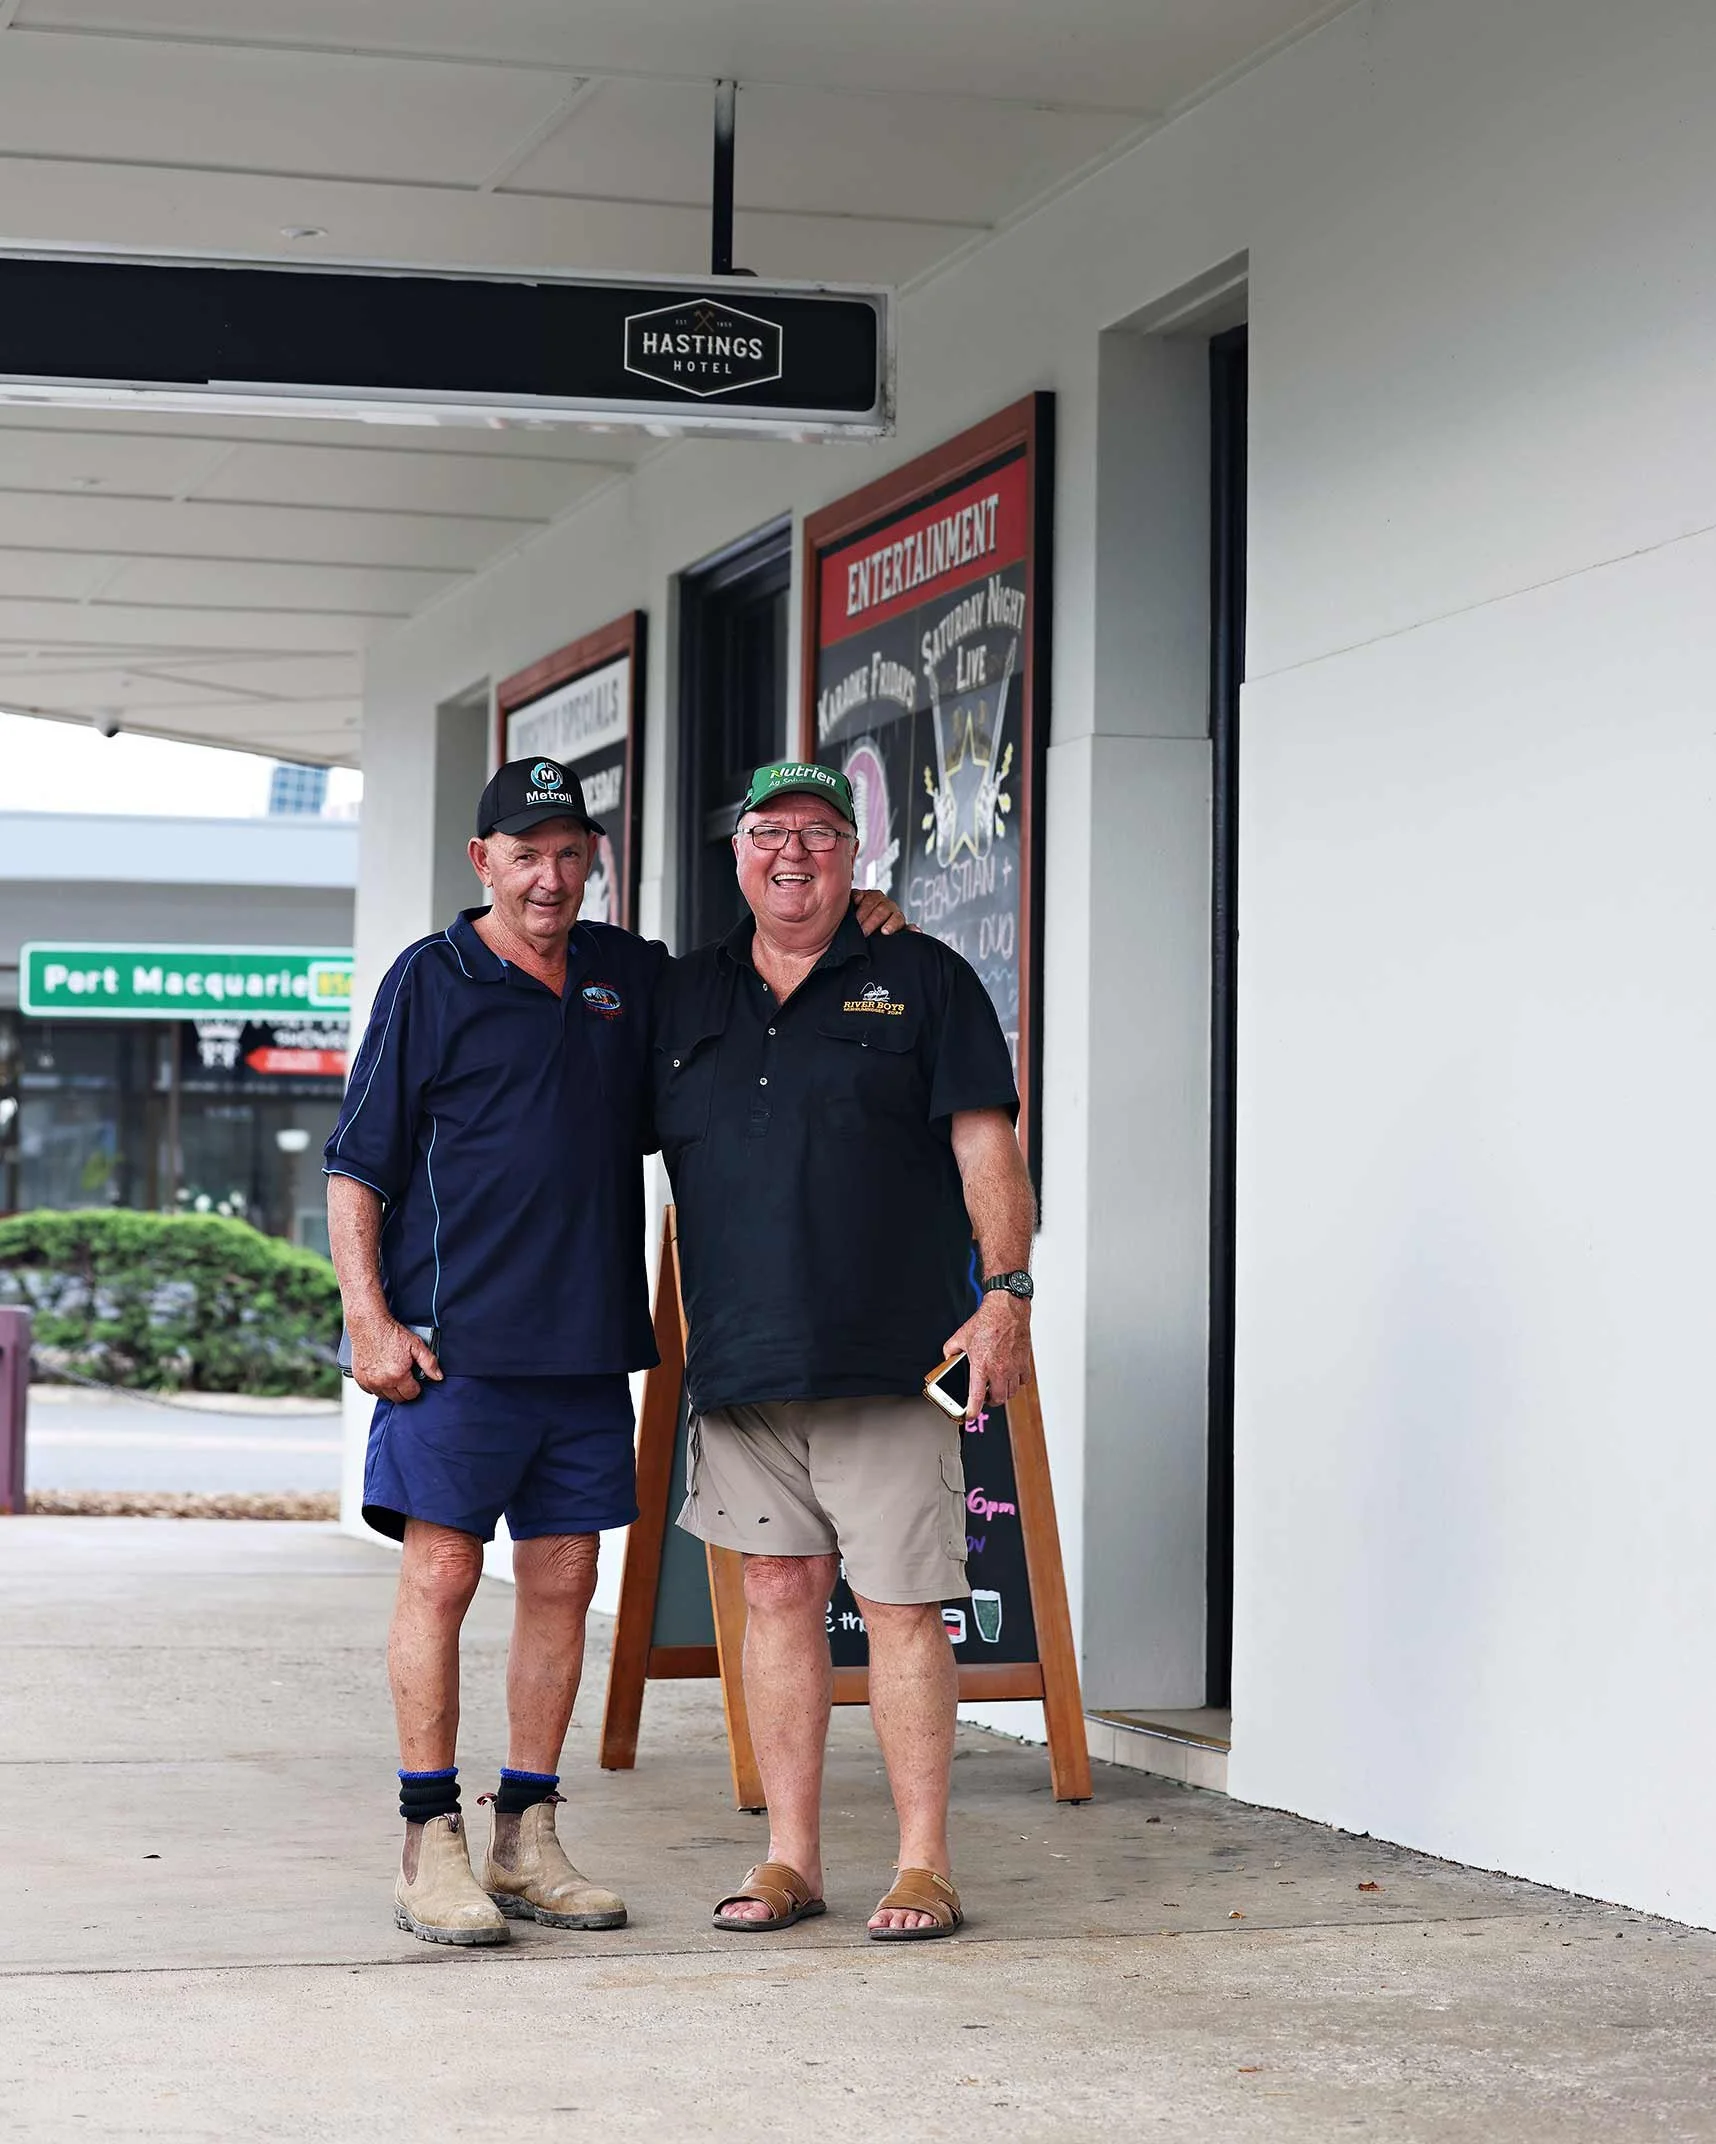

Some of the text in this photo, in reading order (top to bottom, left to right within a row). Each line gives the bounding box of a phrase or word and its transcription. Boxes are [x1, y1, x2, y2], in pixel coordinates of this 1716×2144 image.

[643, 332, 763, 361] HASTINGS
[673, 360, 732, 375] HOTEL
[847, 494, 999, 617] ENTERTAINMENT
[921, 574, 1026, 671] SATURDAY NIGHT
[956, 644, 987, 691] LIVE
[540, 770, 555, 781] M
[769, 765, 837, 787] Nutrien
[526, 790, 573, 804] Metroll
[43, 963, 120, 995] Port
[132, 966, 309, 1002] Macquarie
[876, 1002, 905, 1011] BOYS
